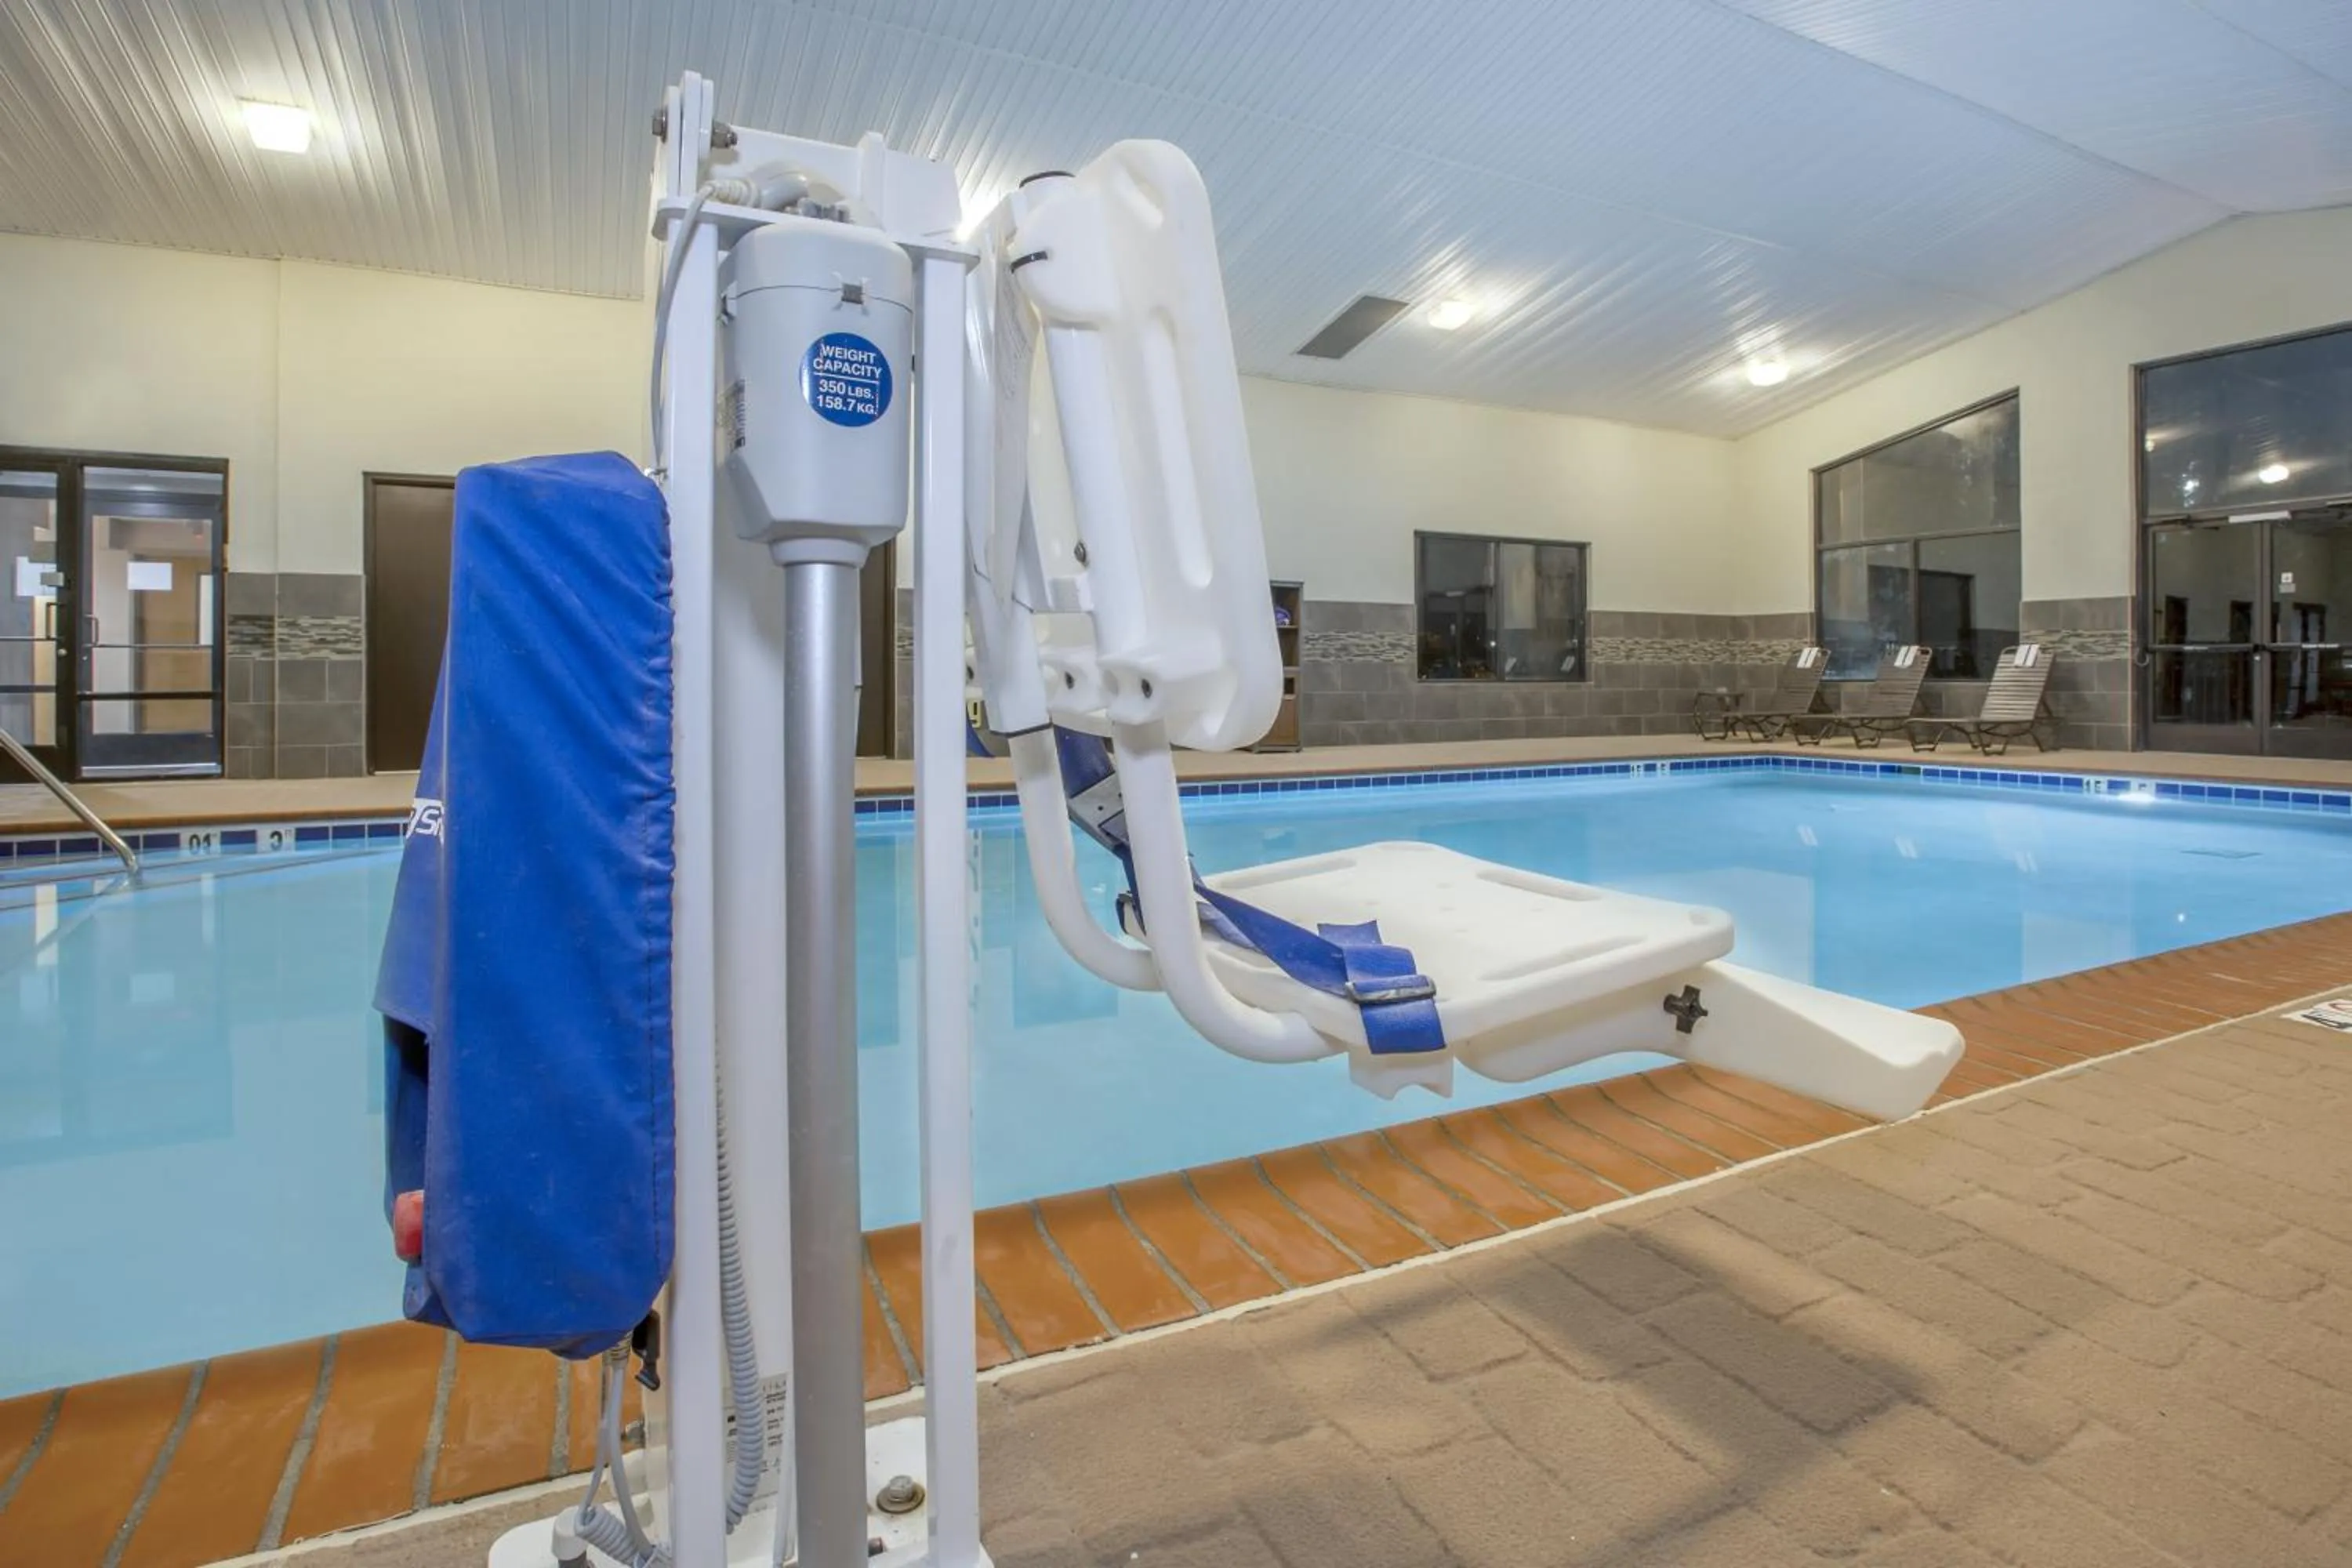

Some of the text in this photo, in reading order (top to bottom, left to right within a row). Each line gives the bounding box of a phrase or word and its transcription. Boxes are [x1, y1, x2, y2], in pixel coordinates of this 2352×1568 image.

[821, 343, 877, 364] WEIGHT
[813, 358, 882, 378] CAPACITY
[819, 379, 874, 399] 350 LBS.
[816, 395, 856, 412] 158.7
